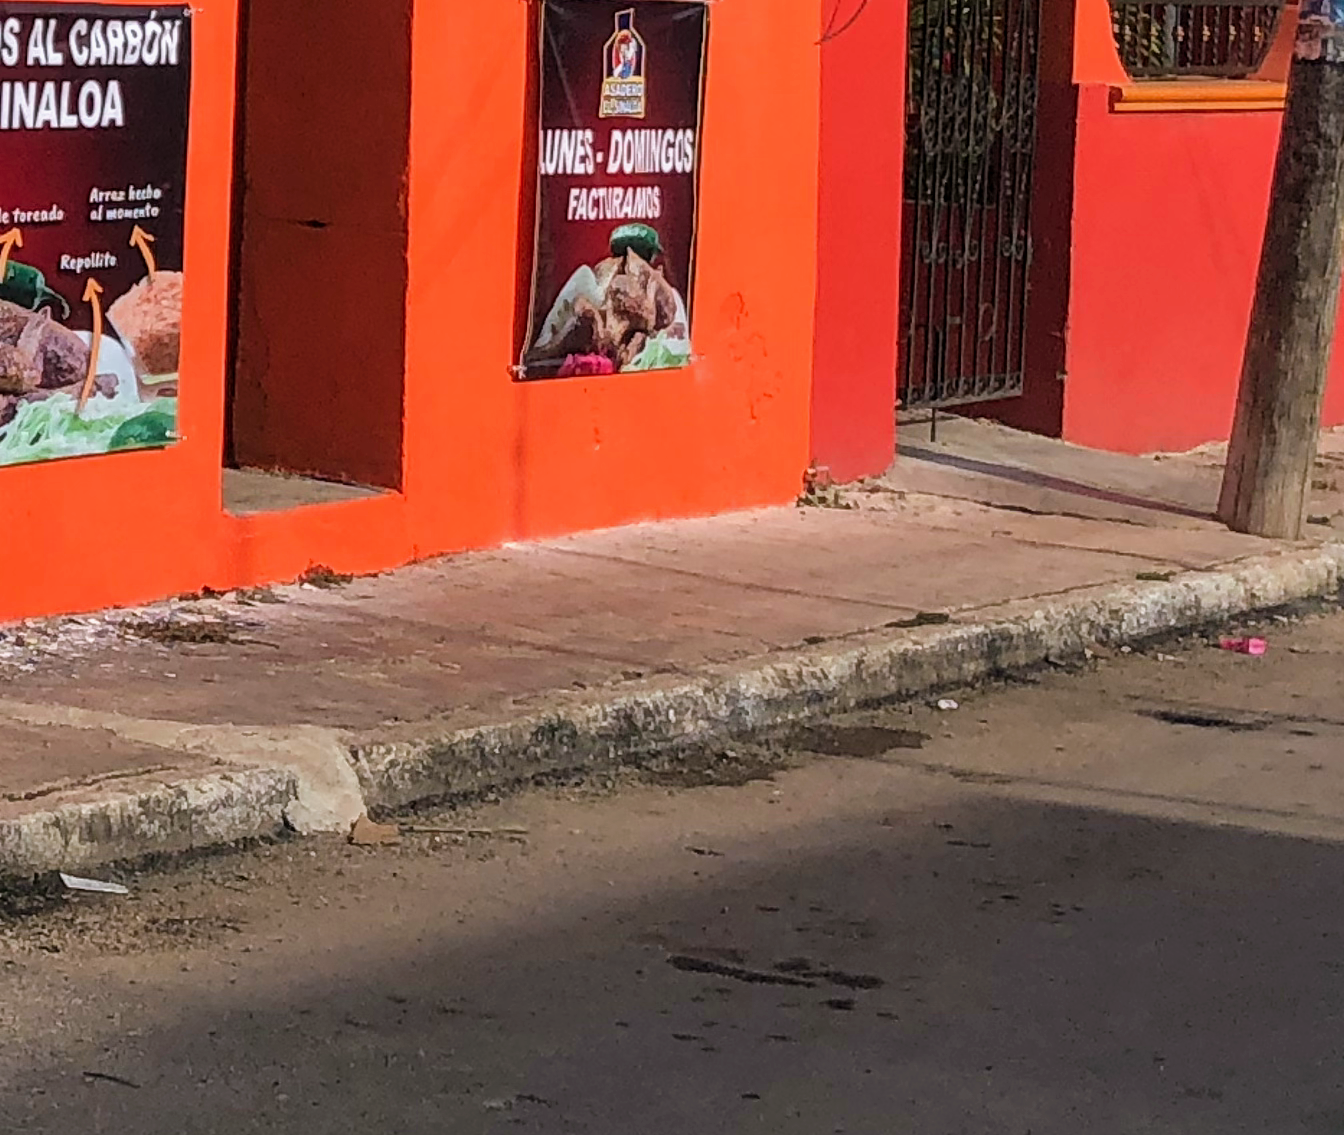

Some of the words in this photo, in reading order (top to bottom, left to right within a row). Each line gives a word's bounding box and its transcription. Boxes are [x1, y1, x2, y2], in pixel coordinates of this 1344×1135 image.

[27, 18, 63, 66] AL
[69, 10, 182, 66] CARBÓN
[606, 128, 694, 174] DOMINGOS
[128, 184, 162, 200] hecho
[567, 185, 661, 221] FACTURAMOS
[12, 204, 64, 223] toreado
[90, 205, 104, 221] al
[106, 204, 160, 220] momento
[60, 251, 117, 274] Repollito
